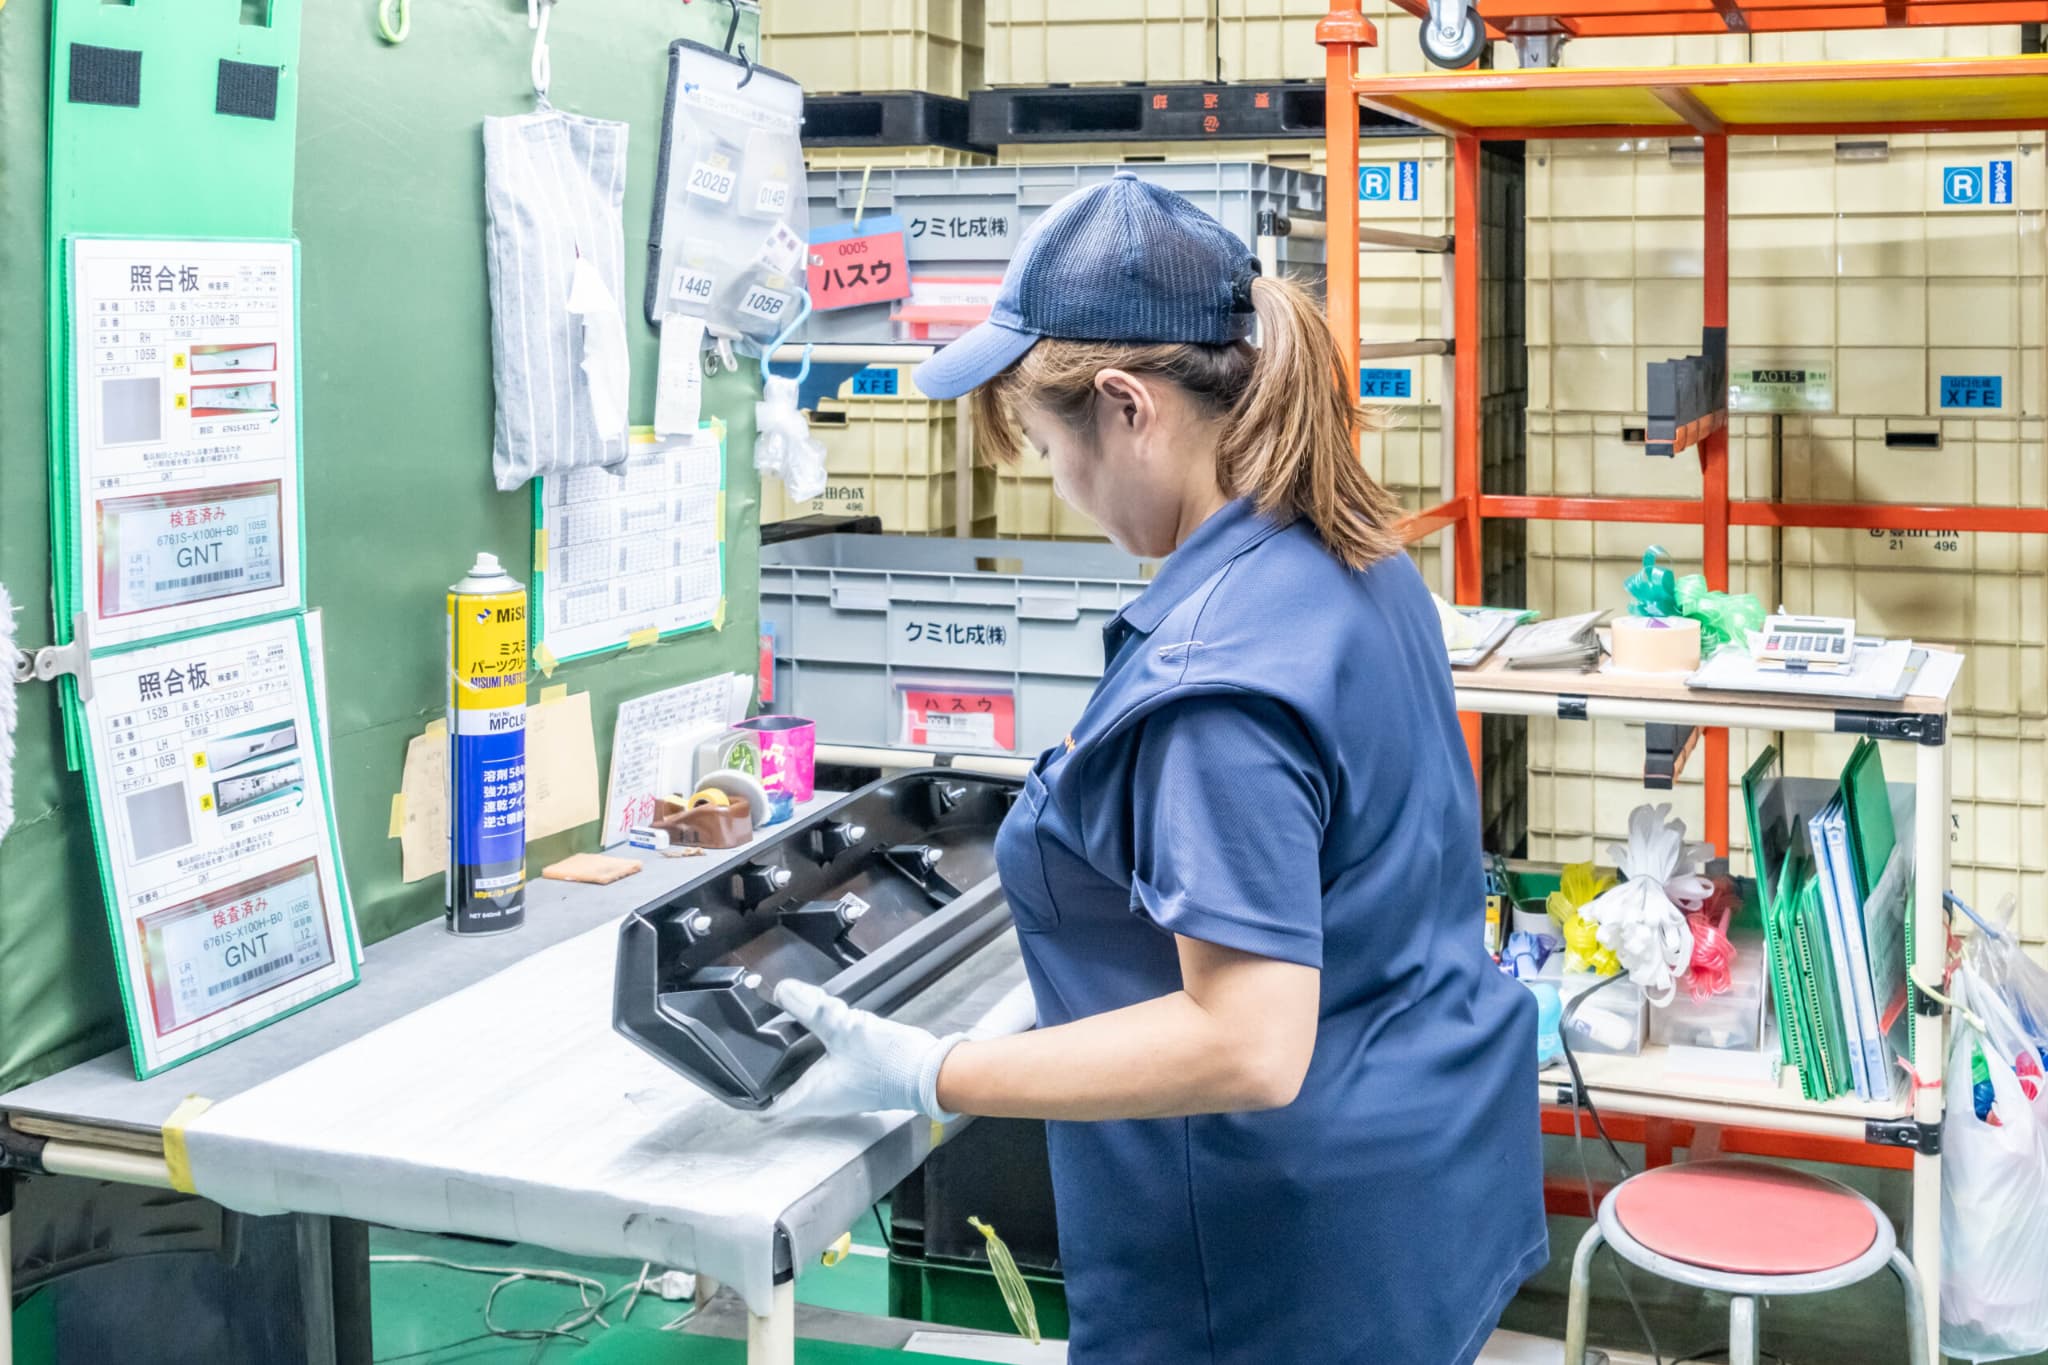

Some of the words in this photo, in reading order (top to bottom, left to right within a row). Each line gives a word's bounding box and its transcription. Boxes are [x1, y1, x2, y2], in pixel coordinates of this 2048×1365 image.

[692, 169, 731, 195] 202B
[1366, 173, 1383, 195] R
[1953, 174, 1973, 198] R
[760, 187, 786, 207] 014B
[838, 241, 869, 256] 0005
[130, 264, 200, 294] 照合板
[822, 260, 893, 292] ハスウ
[678, 276, 713, 298] 144B
[747, 294, 784, 315] 105B
[857, 380, 894, 393] XFE
[1758, 369, 1799, 383] A015
[1364, 381, 1405, 396] XFE
[1946, 389, 1996, 404] XFE
[170, 506, 227, 528] 検査済み
[176, 542, 224, 568] GNT
[1889, 539, 1904, 551] 21
[1934, 541, 1958, 552] 496
[138, 661, 211, 703] 照合板
[470, 675, 502, 690] MISUMI
[146, 705, 169, 721] 152B
[925, 697, 993, 713] ハスウ
[153, 753, 177, 770] 105B
[212, 896, 269, 929] 検査済み
[224, 932, 270, 969] GNT
